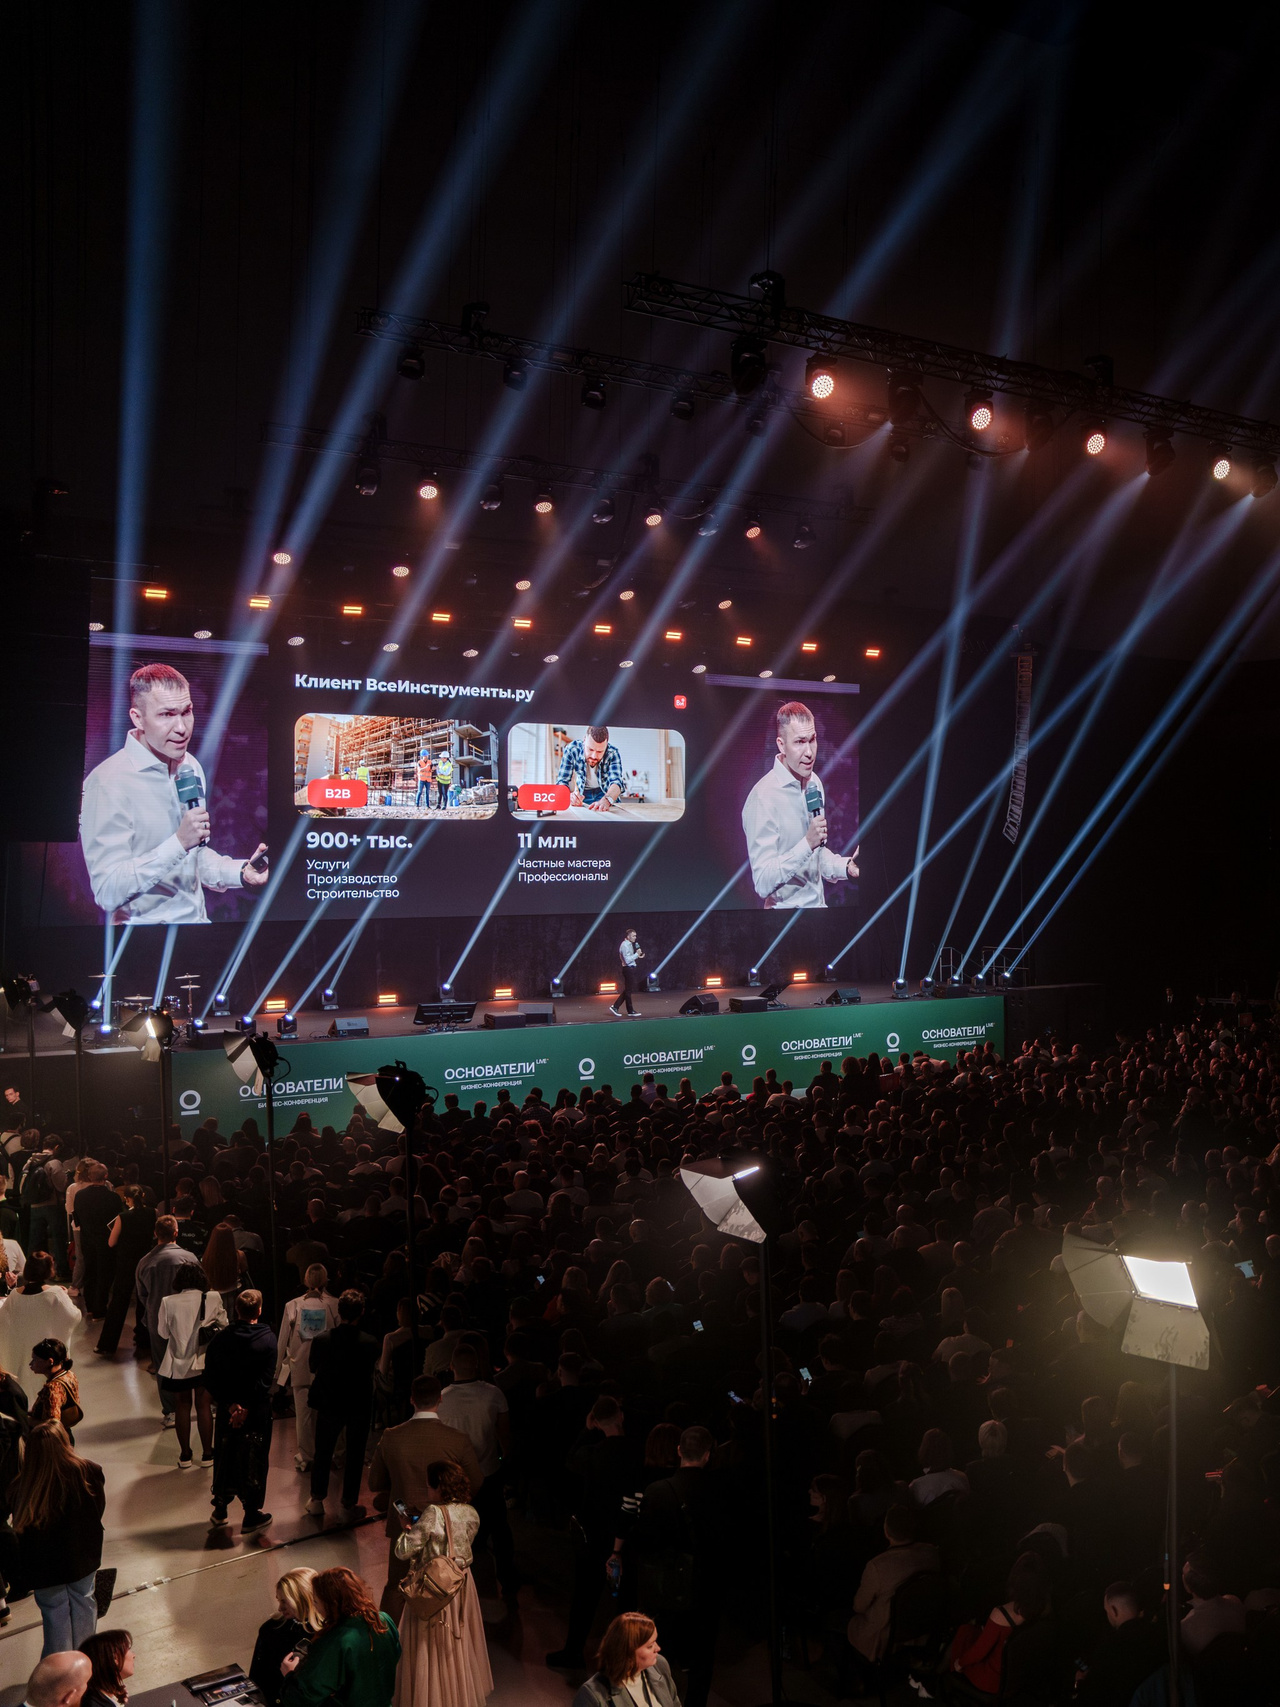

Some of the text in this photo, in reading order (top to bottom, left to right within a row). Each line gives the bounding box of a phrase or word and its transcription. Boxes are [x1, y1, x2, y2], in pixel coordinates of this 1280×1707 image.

[295, 674, 535, 701] Клиент ВсеИнструменты.ру
[325, 788, 351, 799] B2B
[533, 793, 555, 802] B2C
[306, 832, 413, 848] 900+ тыс.
[517, 833, 577, 848] 11 млн
[306, 860, 350, 872] Услуги
[518, 859, 611, 869] Частные мастера
[307, 874, 398, 886] Производство
[518, 872, 609, 884] Профессионалы
[306, 889, 400, 900] Строительство
[922, 1025, 985, 1040] ОСНОВАТЕЛИ
[781, 1035, 852, 1051] ОСНОВАТЕЛИ
[933, 1040, 977, 1048] БИЗНЕС-КОНФЕРЕНЦИЯ
[623, 1048, 704, 1065] ОСНОВАТЕЛИ
[794, 1051, 842, 1061] БИЗНЕС-КОНФЕРЕНЦИЯ
[444, 1062, 535, 1080] ОСНОВАТЕЛИ
[461, 1080, 522, 1090] БИЗНЕС-КОНФЕРЕНЦИЯ
